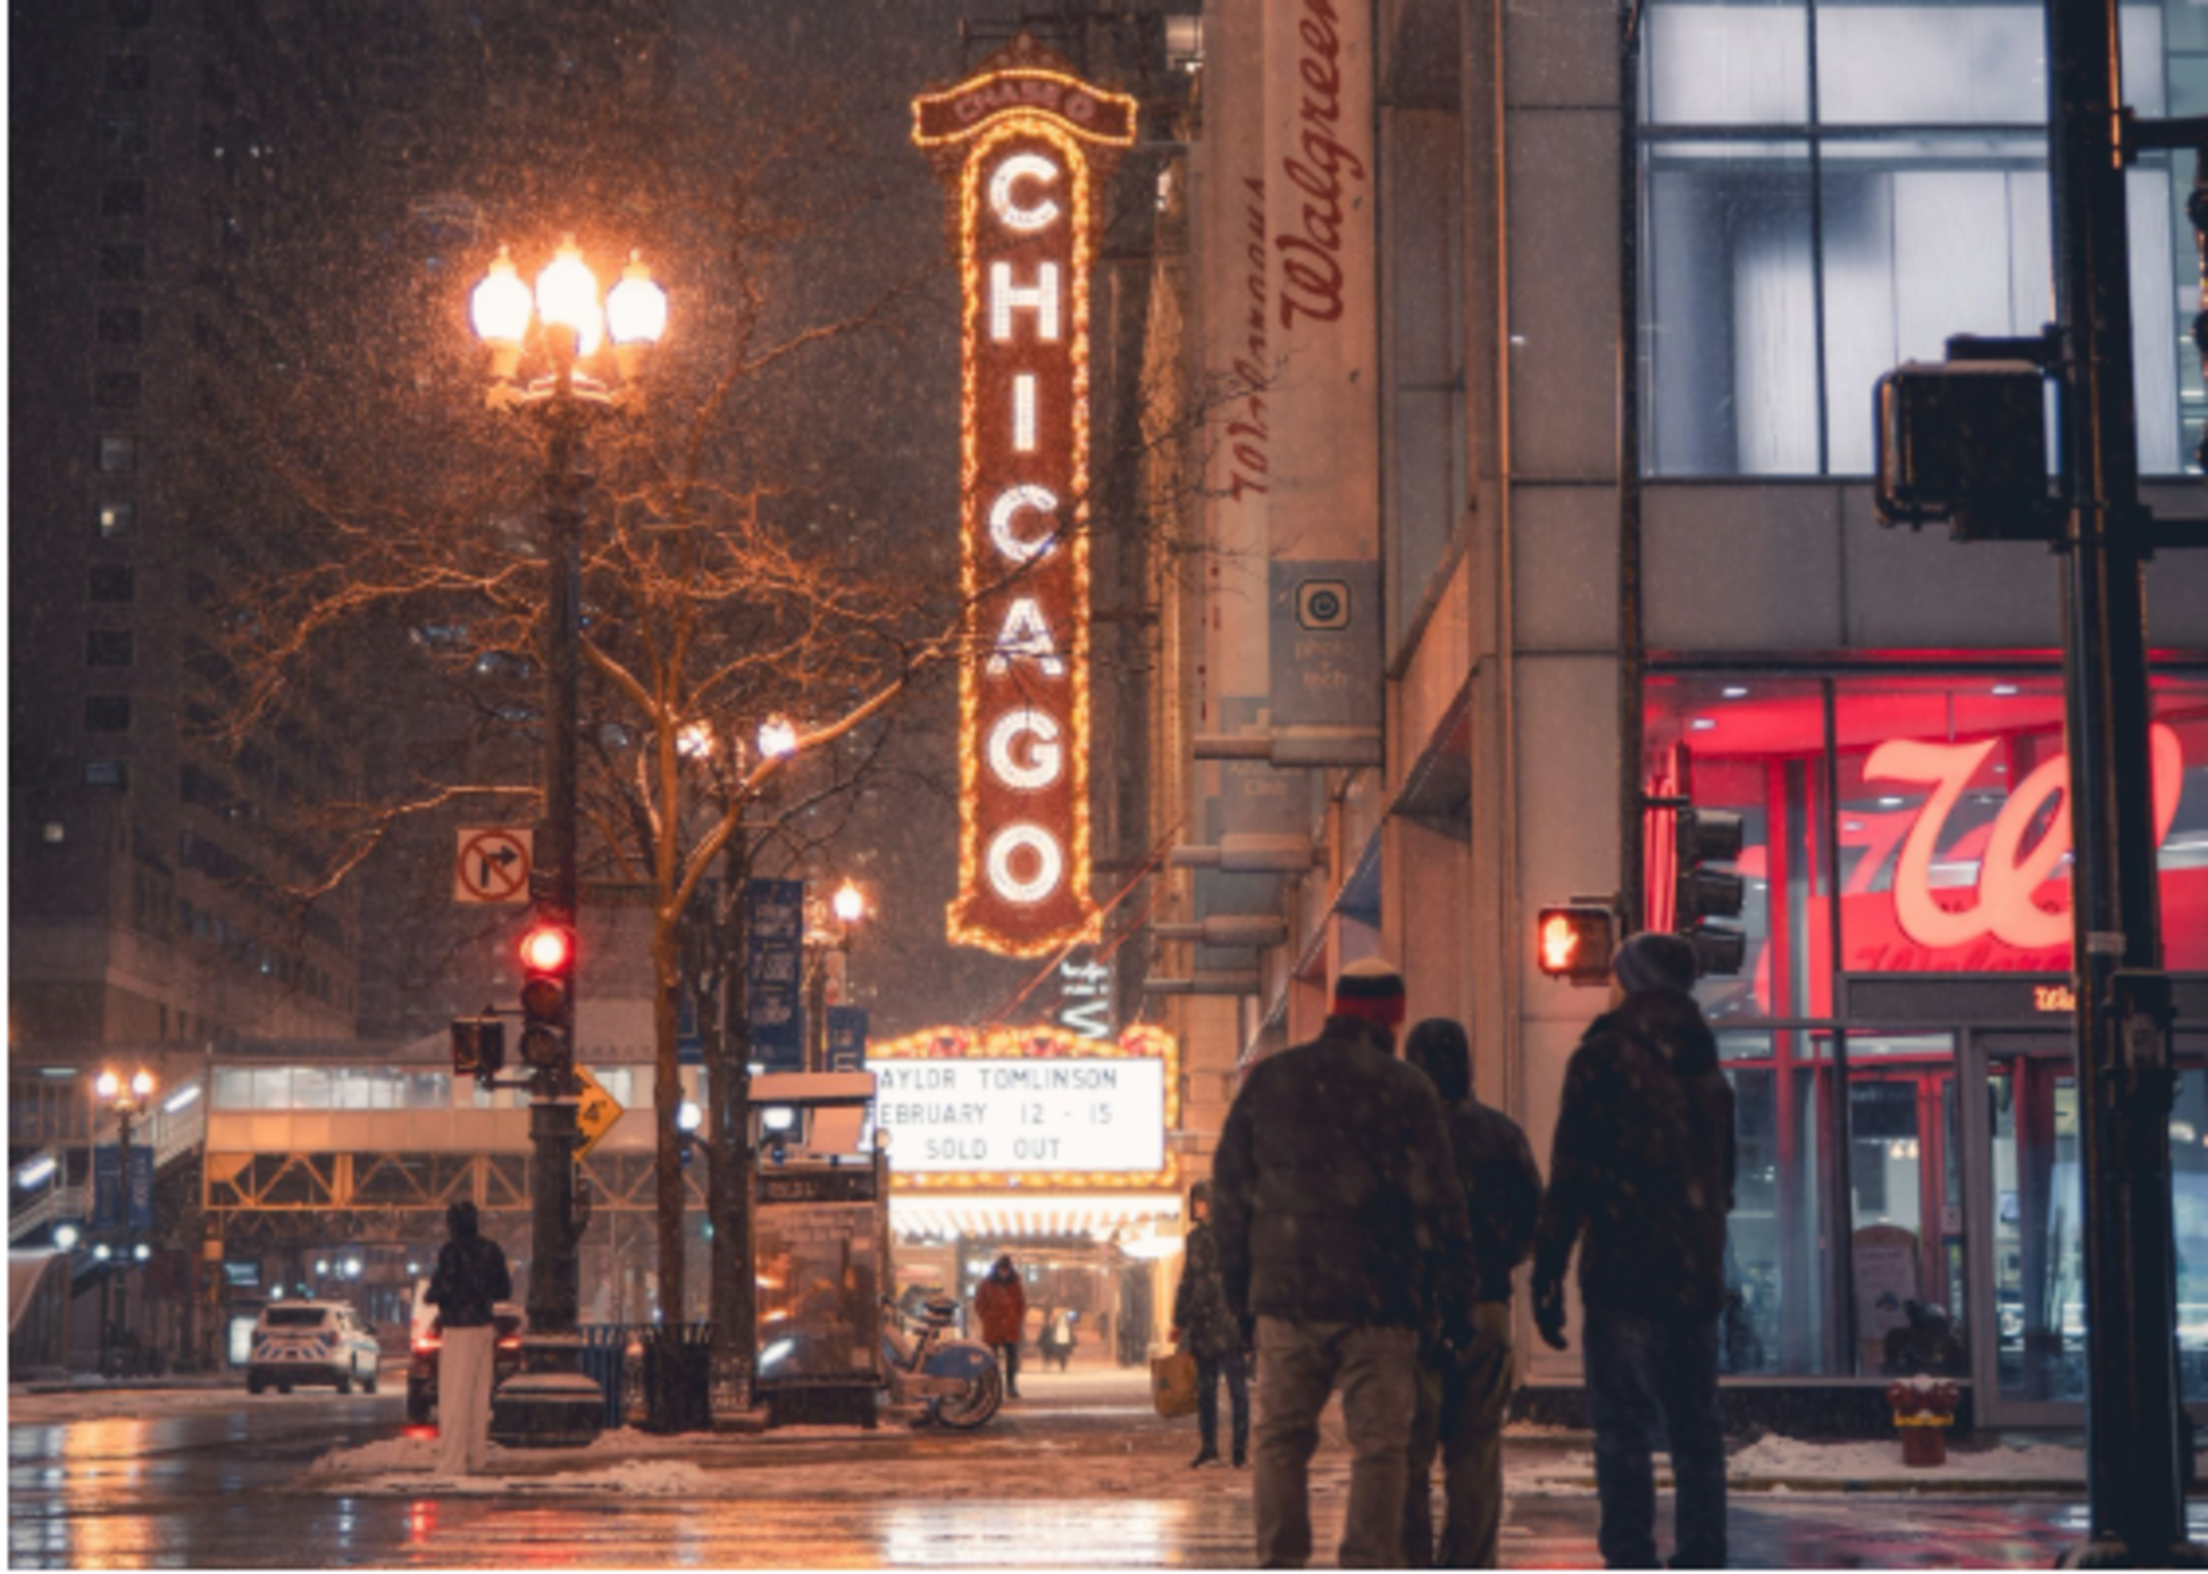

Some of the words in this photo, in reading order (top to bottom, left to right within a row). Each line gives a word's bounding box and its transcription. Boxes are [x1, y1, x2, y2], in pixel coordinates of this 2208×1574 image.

[987, 154, 1063, 905] CHICAGO
[879, 1068, 956, 1090] AYLOR
[978, 1068, 1117, 1090] TOMLINSON
[1020, 1103, 1045, 1124] 12
[1090, 1103, 1113, 1124] 15
[926, 1137, 987, 1160] SOLD
[1013, 1137, 1061, 1160] OUT
